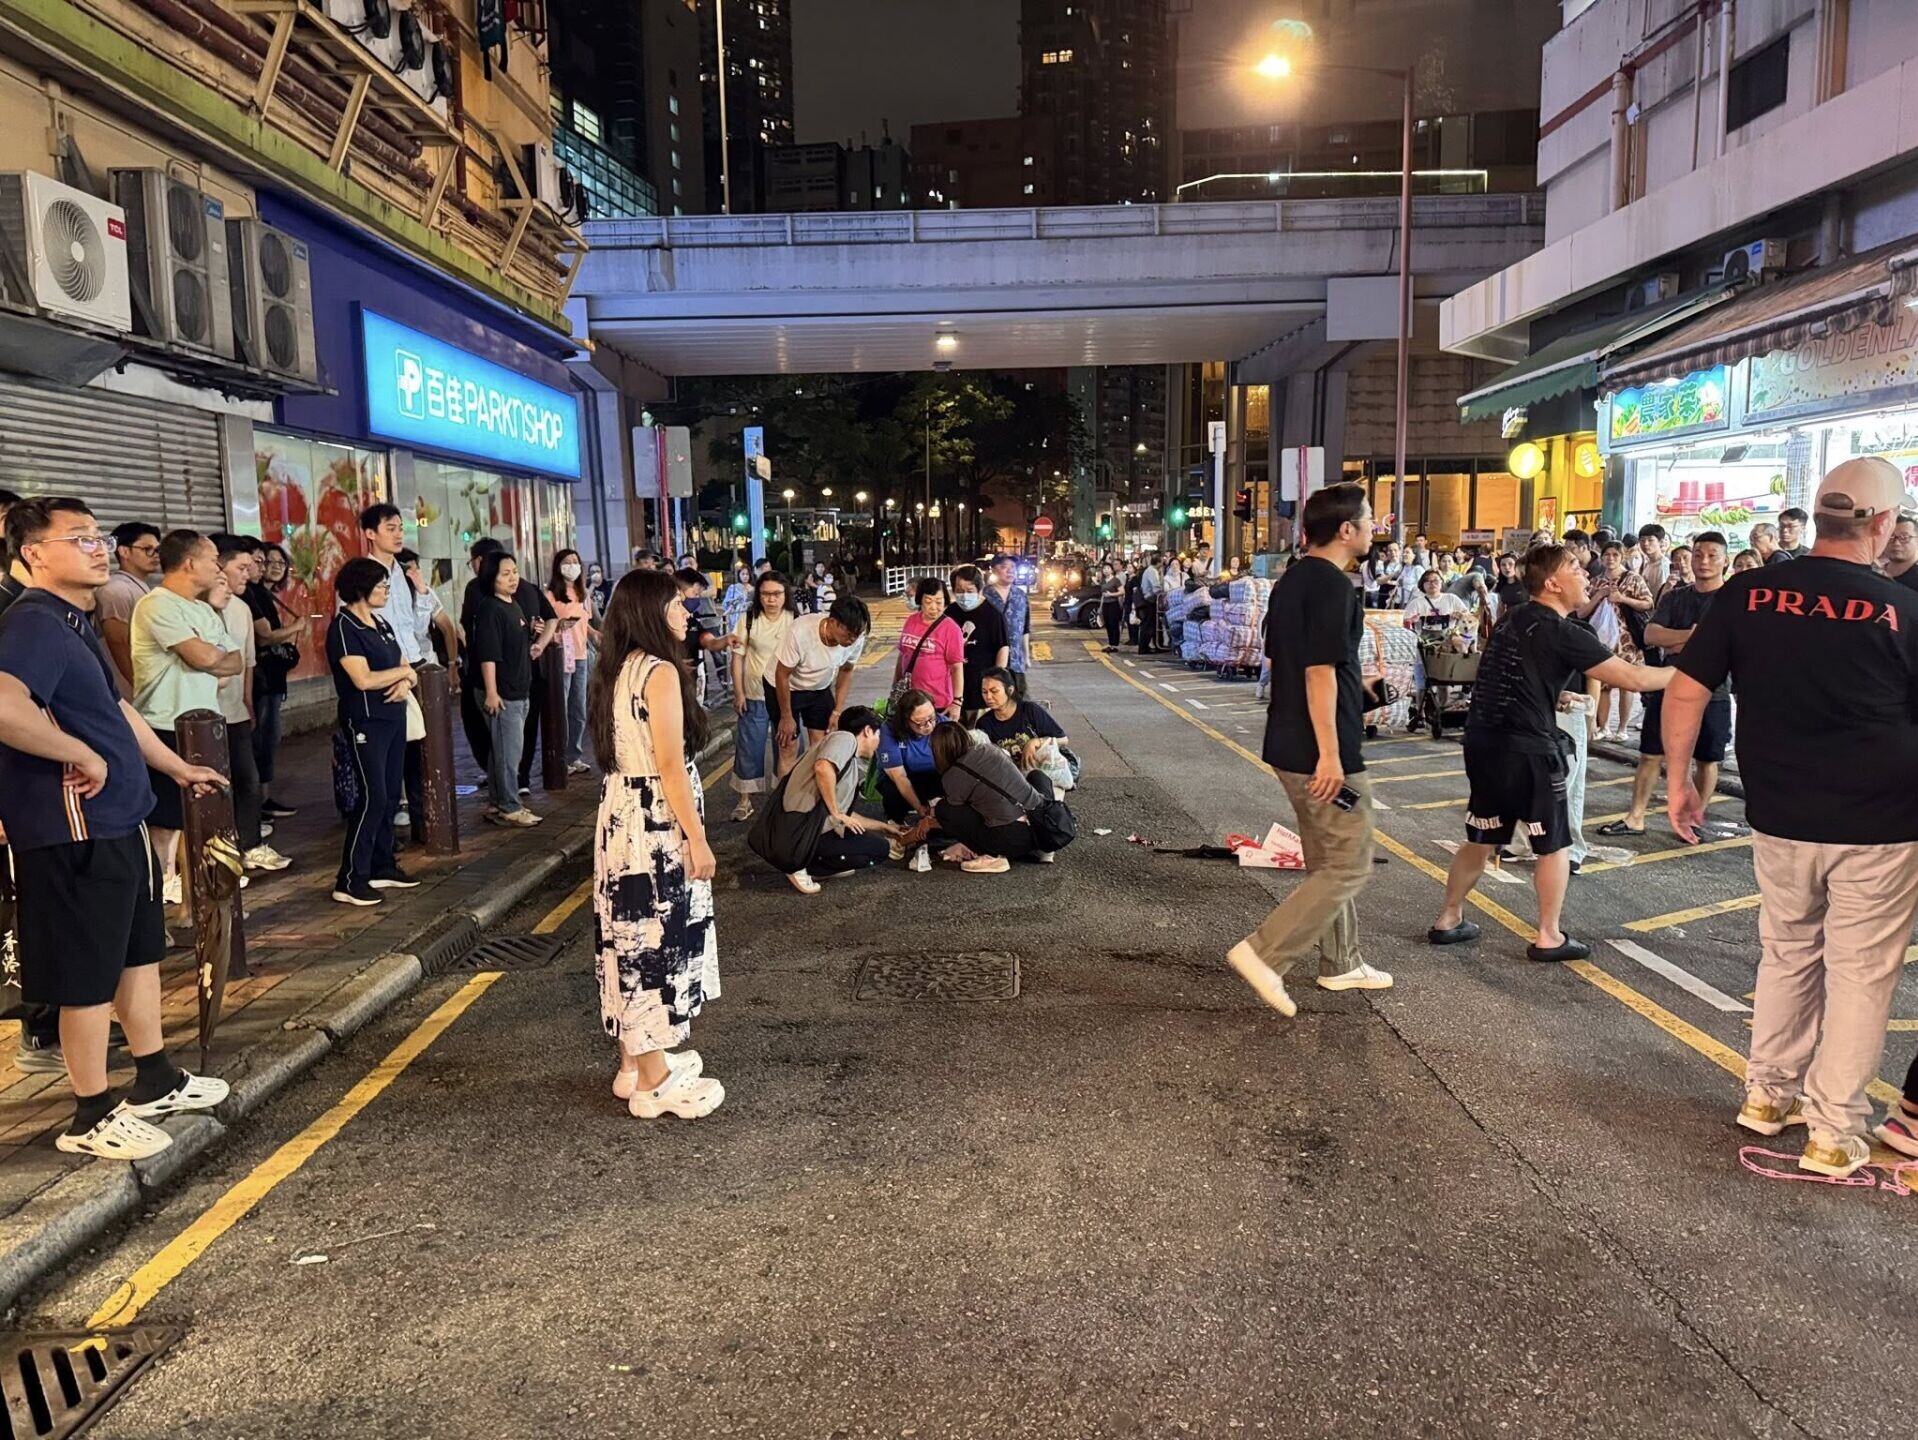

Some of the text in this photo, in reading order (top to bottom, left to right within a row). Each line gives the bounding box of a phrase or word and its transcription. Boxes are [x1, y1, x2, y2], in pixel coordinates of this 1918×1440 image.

[109, 223, 123, 235] TCL
[425, 367, 465, 425] 百佳
[1641, 381, 1698, 425] 農家菜
[1747, 588, 1899, 632] PRADA
[1, 930, 22, 988] 香港人
